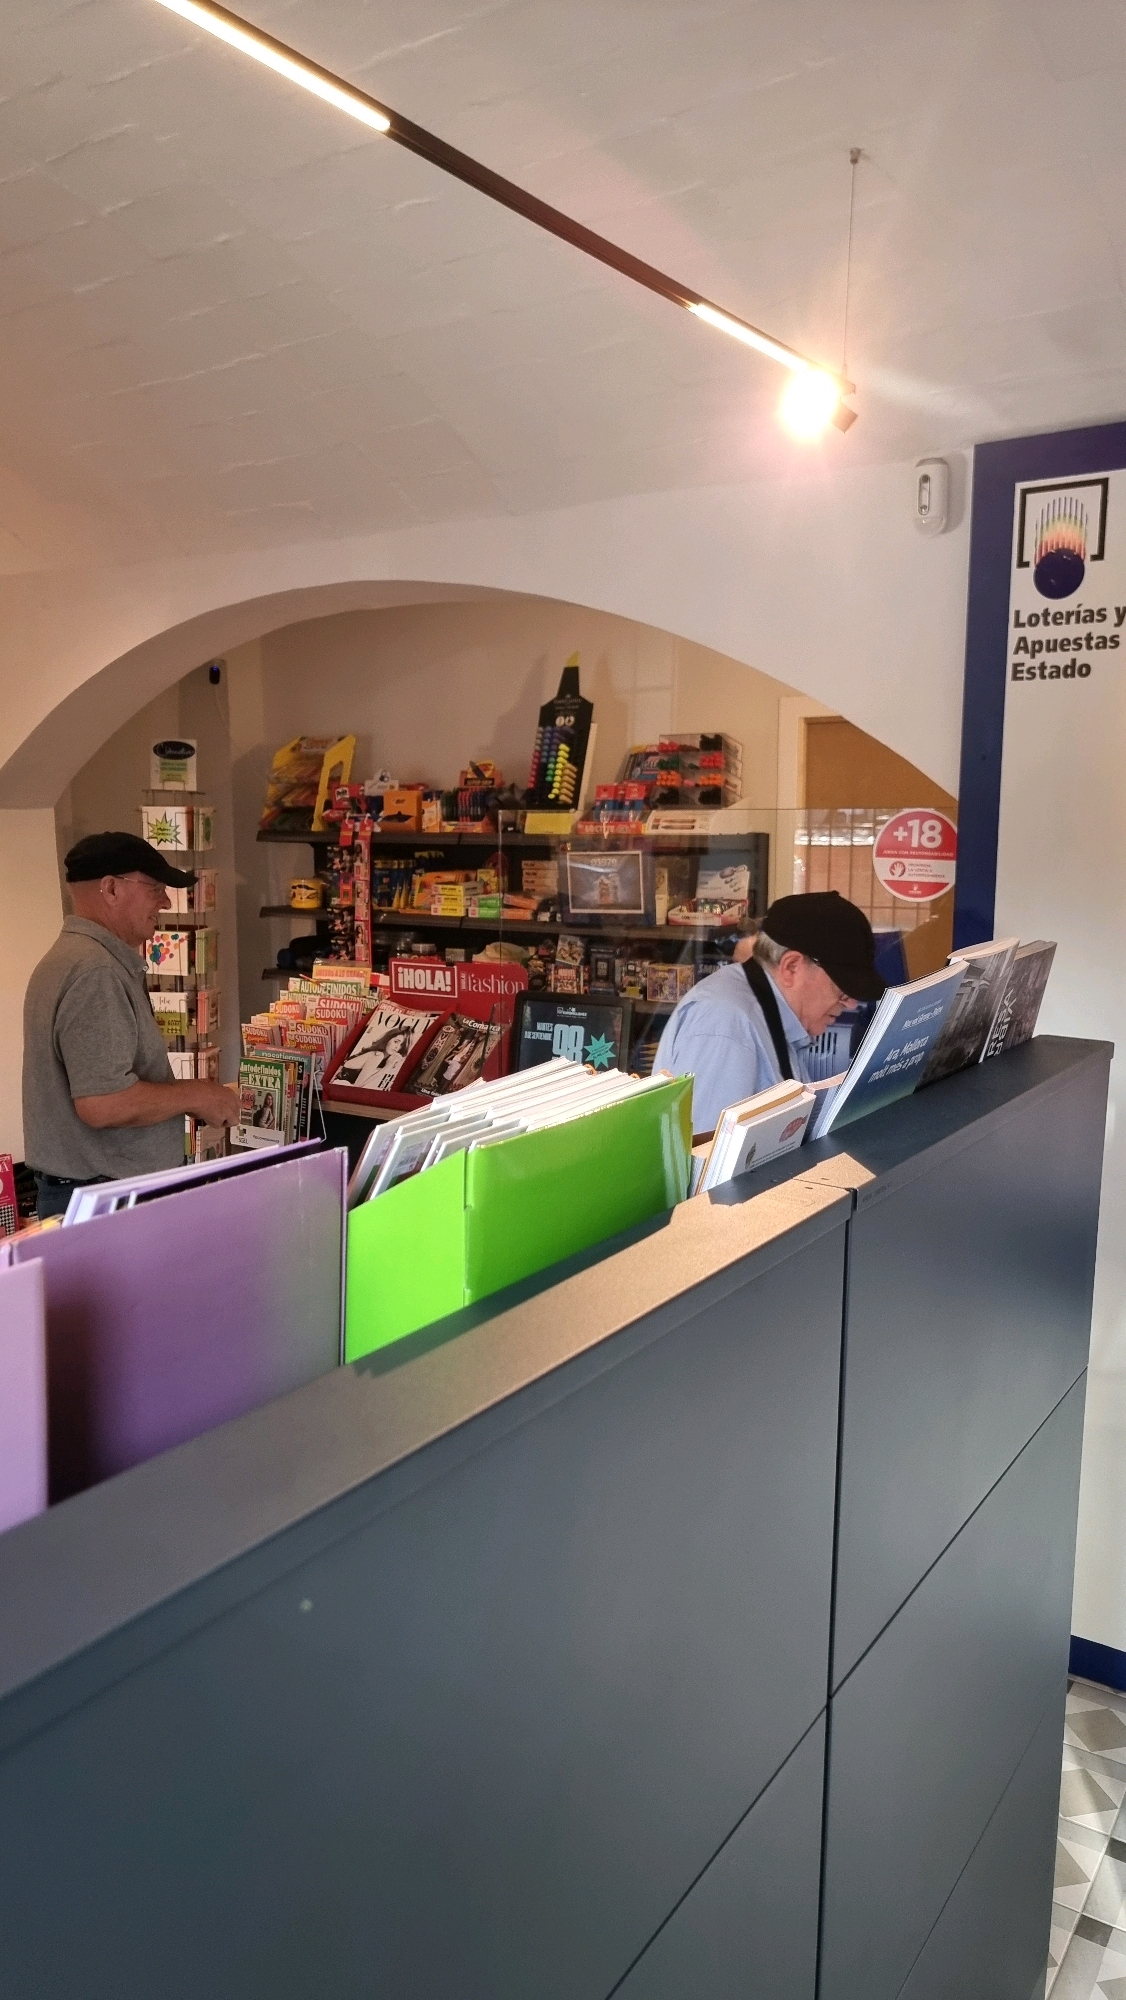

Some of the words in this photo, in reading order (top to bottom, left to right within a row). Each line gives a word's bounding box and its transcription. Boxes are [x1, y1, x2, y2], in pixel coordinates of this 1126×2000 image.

[1013, 604, 1107, 629] Loterías
[1113, 606, 1126, 627] y
[1012, 632, 1120, 659] Apuestas
[1011, 658, 1091, 681] Estado
[893, 820, 942, 849] +18
[300, 979, 357, 995] AUTODEFINIDOS
[397, 966, 452, 992] ¡HOLA!
[468, 973, 524, 995] fashion
[316, 1008, 347, 1019] SUDOKU
[244, 1025, 268, 1037] SUDOKU
[296, 1023, 328, 1035] SUDOKU
[295, 1034, 322, 1045] SUDOKU
[883, 1048, 900, 1064] Ara,
[900, 1035, 930, 1056] Mallorca
[240, 1062, 281, 1076] Autodefinidos
[249, 1074, 281, 1089] EXTRA
